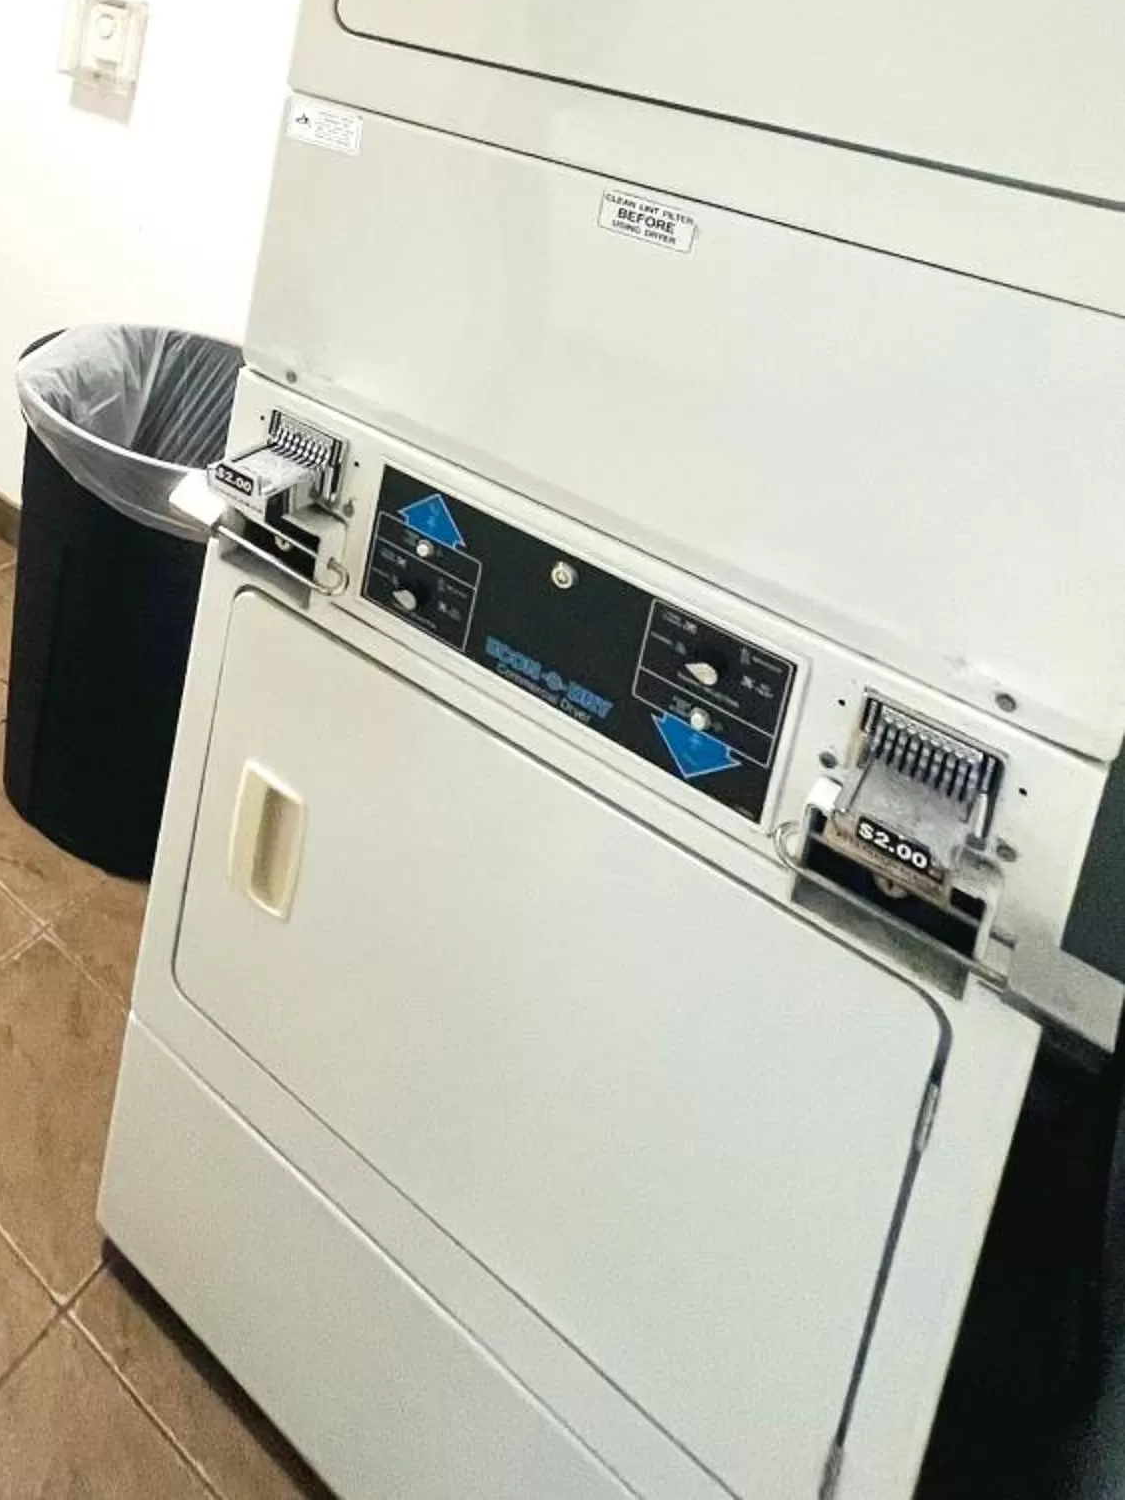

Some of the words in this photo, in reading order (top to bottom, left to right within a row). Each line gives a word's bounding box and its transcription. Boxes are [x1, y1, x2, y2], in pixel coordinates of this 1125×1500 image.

[605, 193, 636, 208] CLEAN
[617, 207, 676, 235] BEFORE
[216, 465, 253, 493] $2.00
[858, 822, 929, 870] $2.00
